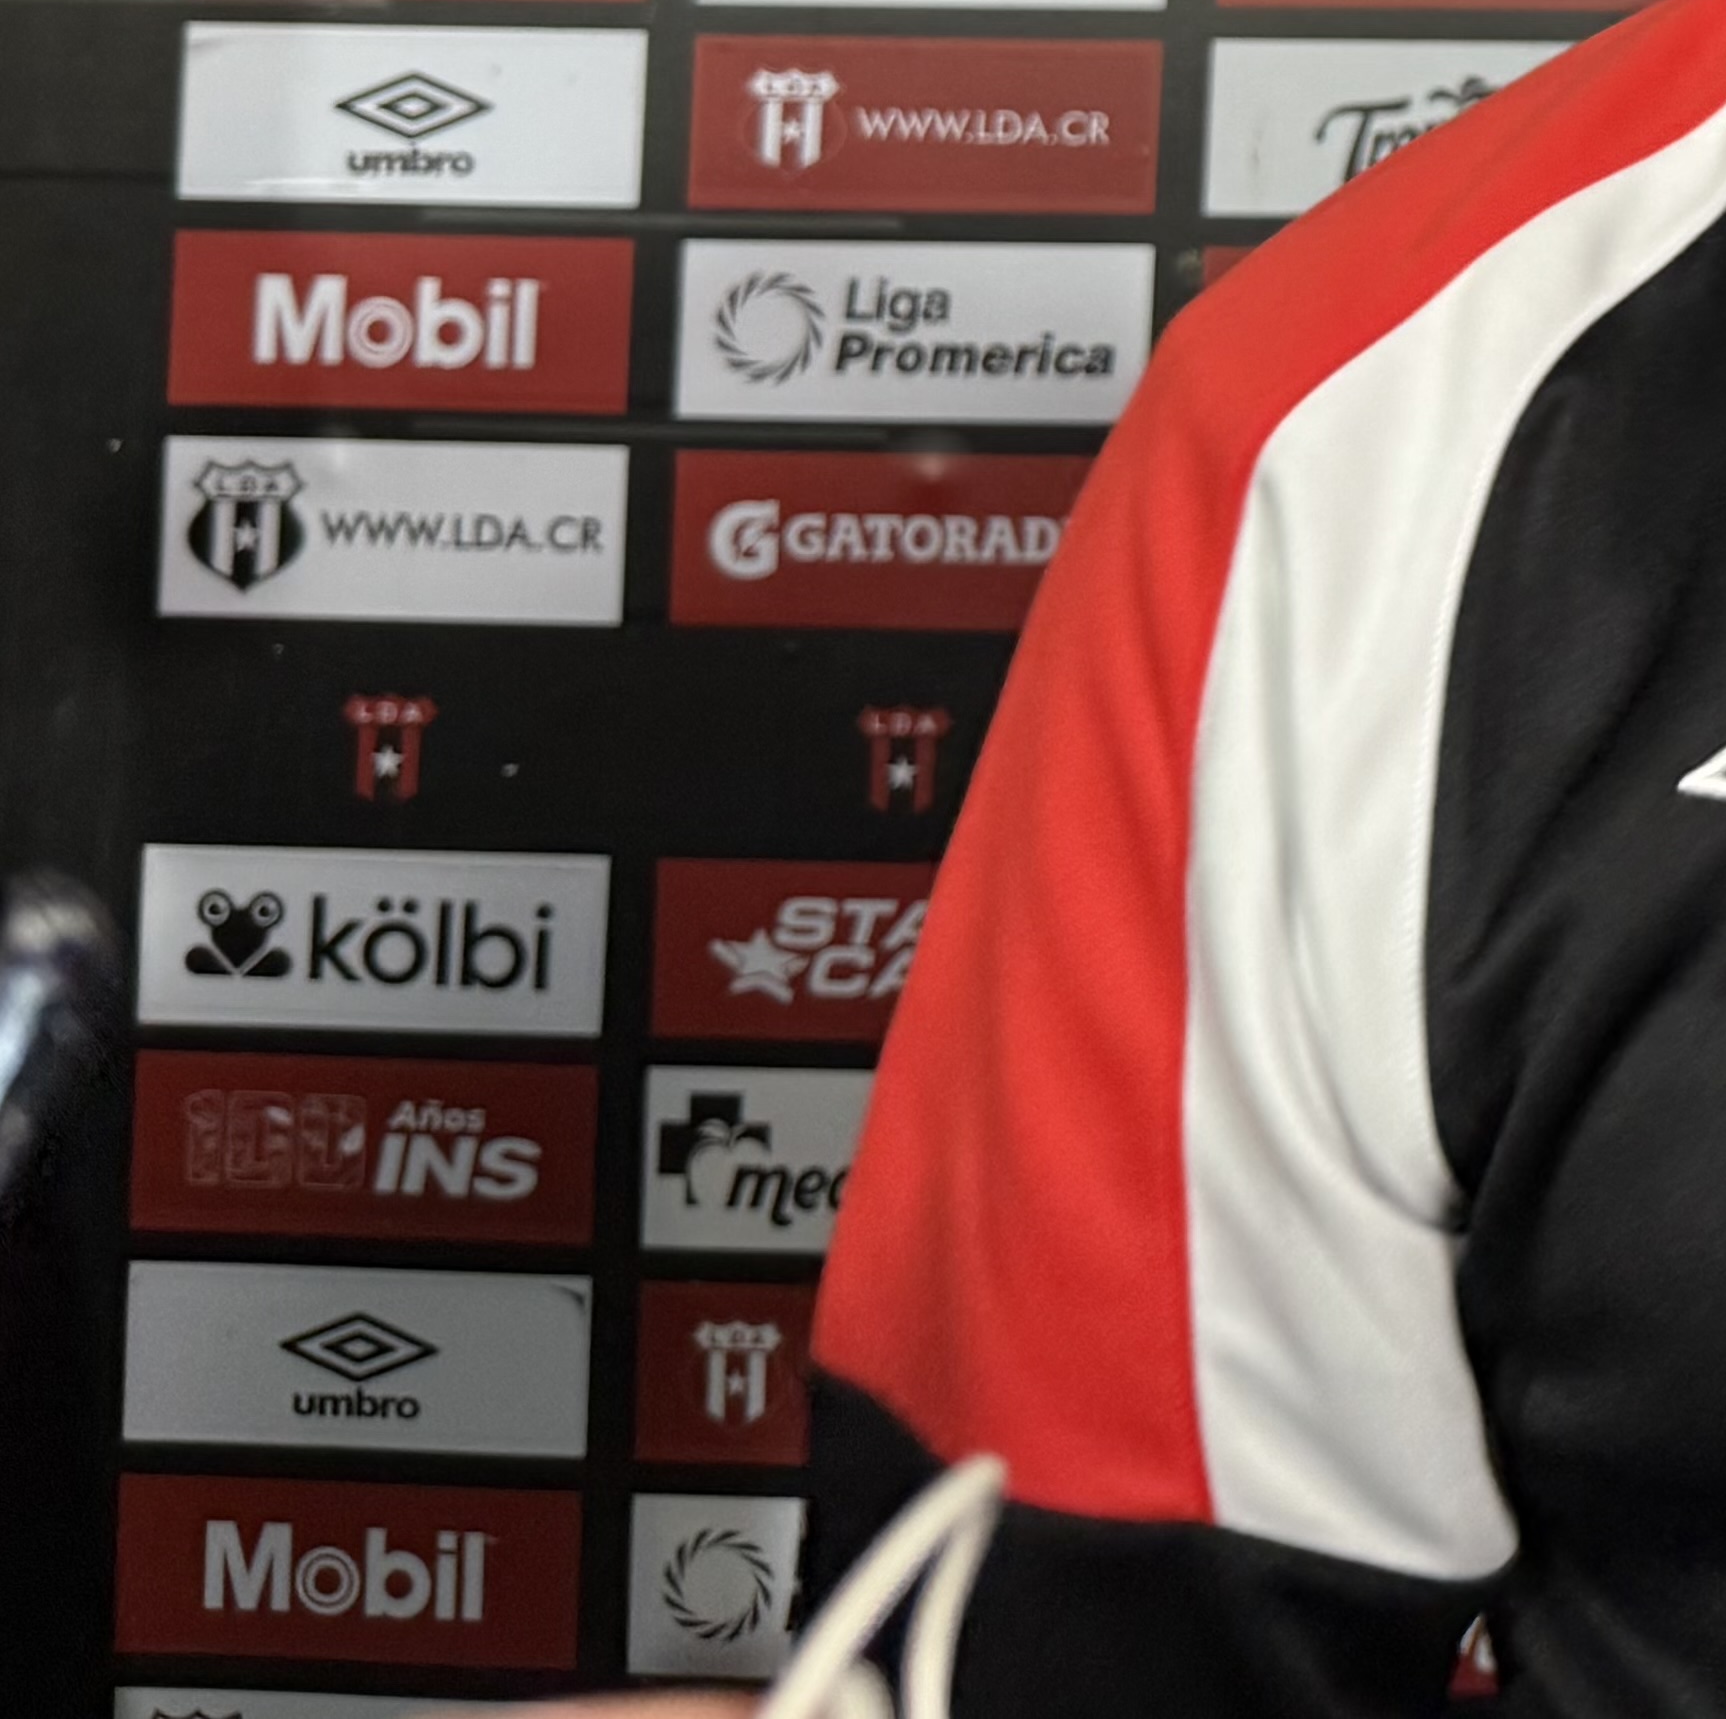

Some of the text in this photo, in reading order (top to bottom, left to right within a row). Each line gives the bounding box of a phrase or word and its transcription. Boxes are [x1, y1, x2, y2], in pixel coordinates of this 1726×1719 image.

[857, 108, 1109, 146] WWW.LDA.CR
[346, 147, 474, 176] umbro
[255, 274, 539, 368] Mobil
[843, 278, 950, 336] Liga
[834, 332, 1115, 378] Promerica
[321, 511, 603, 554] WWW.LDA.CR
[786, 511, 1064, 565] GATORAD
[308, 896, 553, 993] kölbi
[388, 1100, 484, 1132] Años
[374, 1133, 540, 1199] INS
[293, 1386, 420, 1420] umbro
[204, 1521, 485, 1621] Mobil
